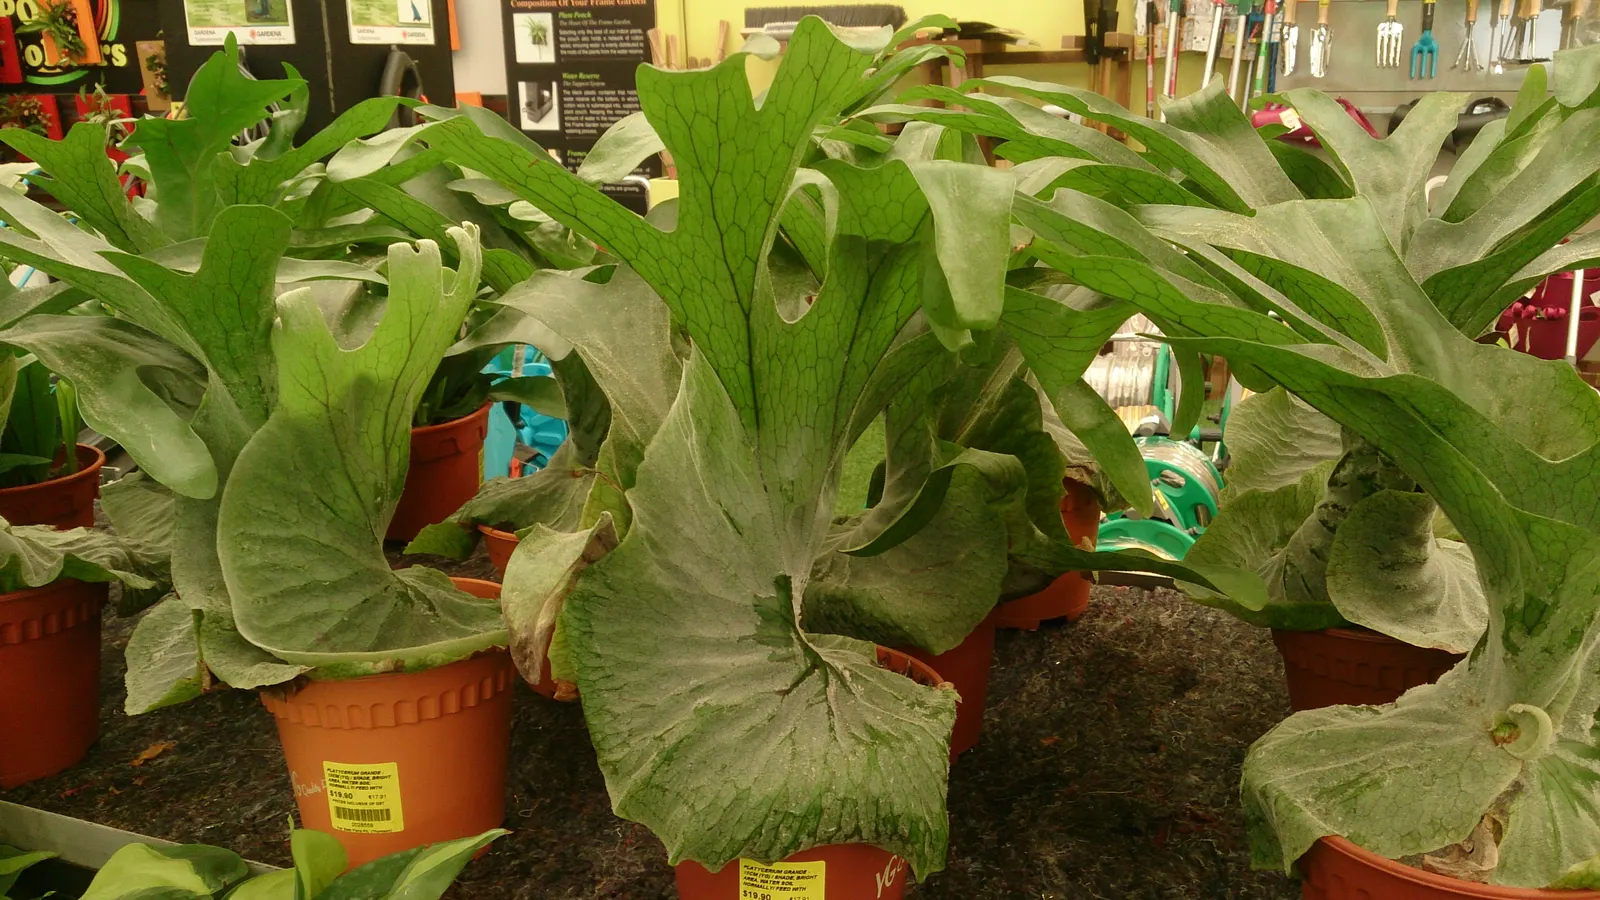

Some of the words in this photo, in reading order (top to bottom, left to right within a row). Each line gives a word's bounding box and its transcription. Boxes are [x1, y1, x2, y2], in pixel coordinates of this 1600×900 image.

[510, 0, 556, 8] Composition
[330, 790, 353, 799] $19.90
[744, 865, 782, 873] PLATYCERIUM
[743, 890, 771, 900] $19.90
